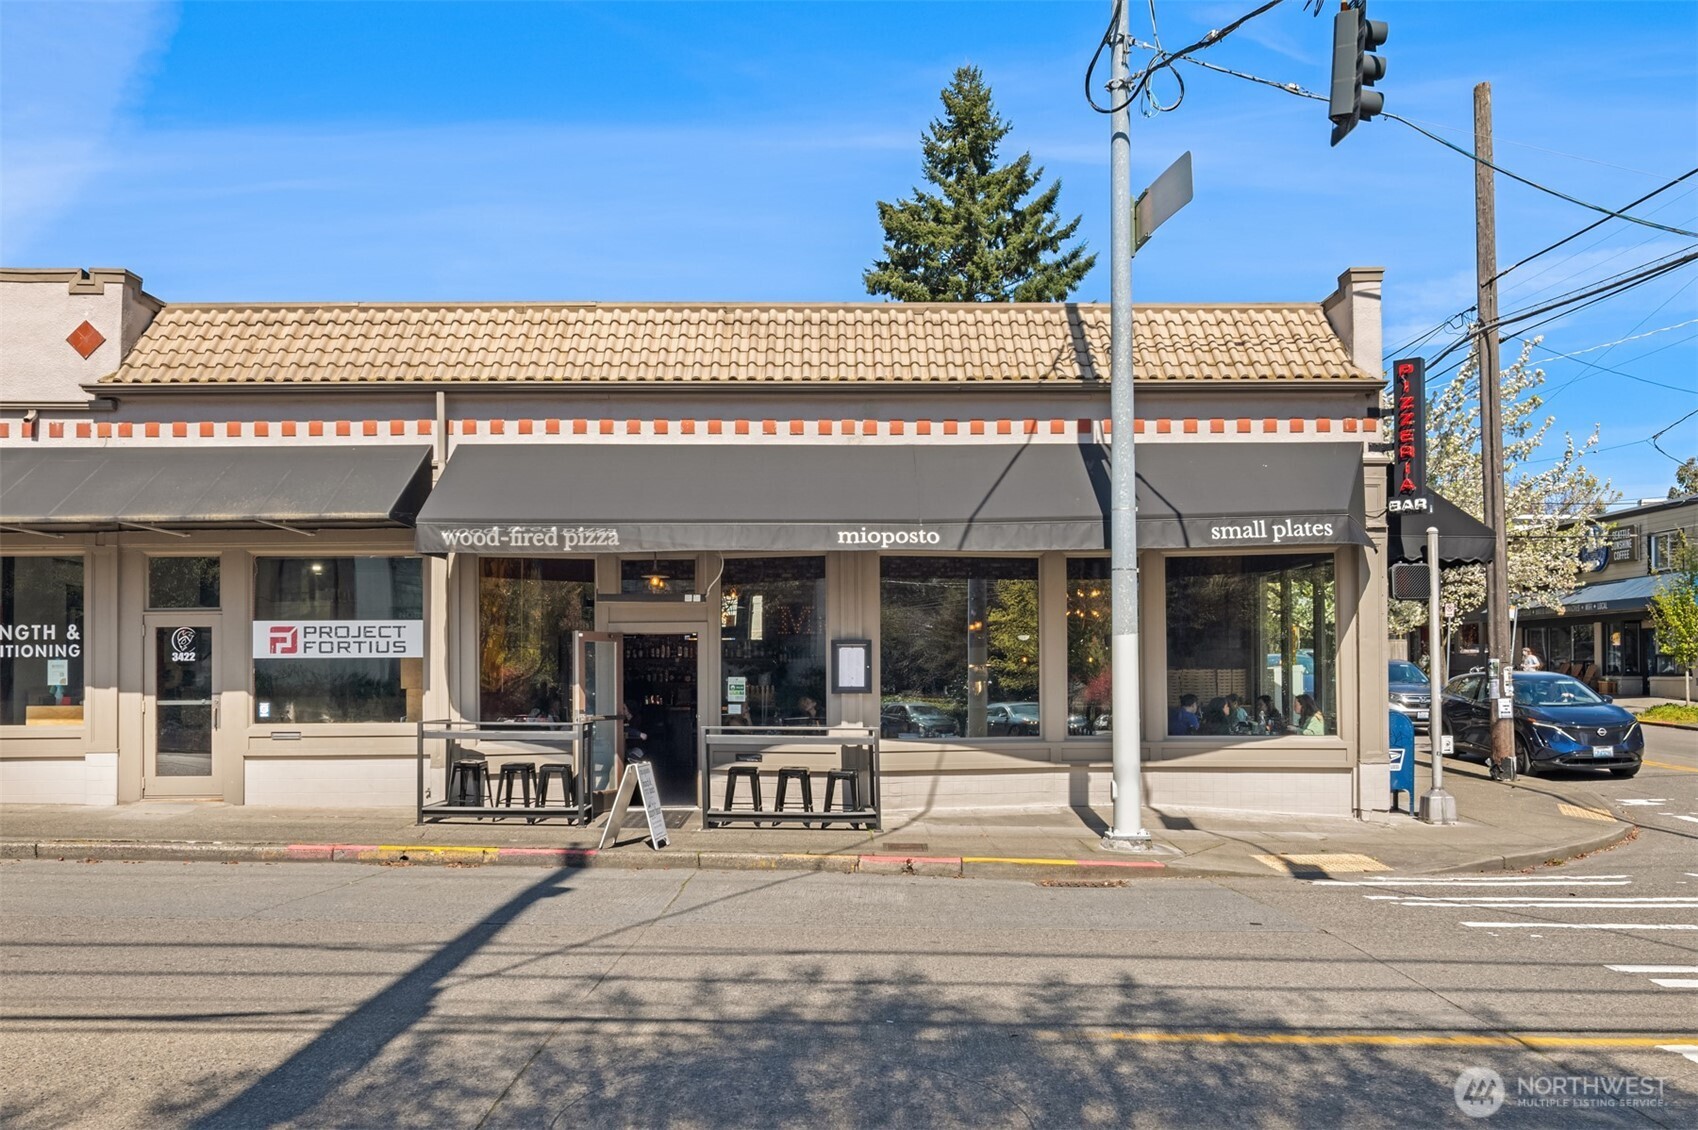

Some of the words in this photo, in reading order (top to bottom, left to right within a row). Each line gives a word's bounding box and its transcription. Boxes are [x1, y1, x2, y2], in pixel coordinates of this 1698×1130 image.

[1398, 364, 1416, 491] PIZZERIA
[1388, 498, 1427, 511] BAR
[837, 527, 940, 548] mioposto
[1211, 520, 1267, 540] small
[1272, 519, 1333, 542] plates
[439, 526, 558, 546] wood-fired
[563, 527, 620, 551] pizza
[1614, 550, 1630, 560] COFFEE
[0, 624, 56, 640] NGTH
[66, 624, 80, 640] &
[303, 626, 407, 639] PROJECT
[0, 644, 81, 658] ITIONING
[303, 641, 407, 654] FORTIUS
[171, 652, 196, 662] 3422
